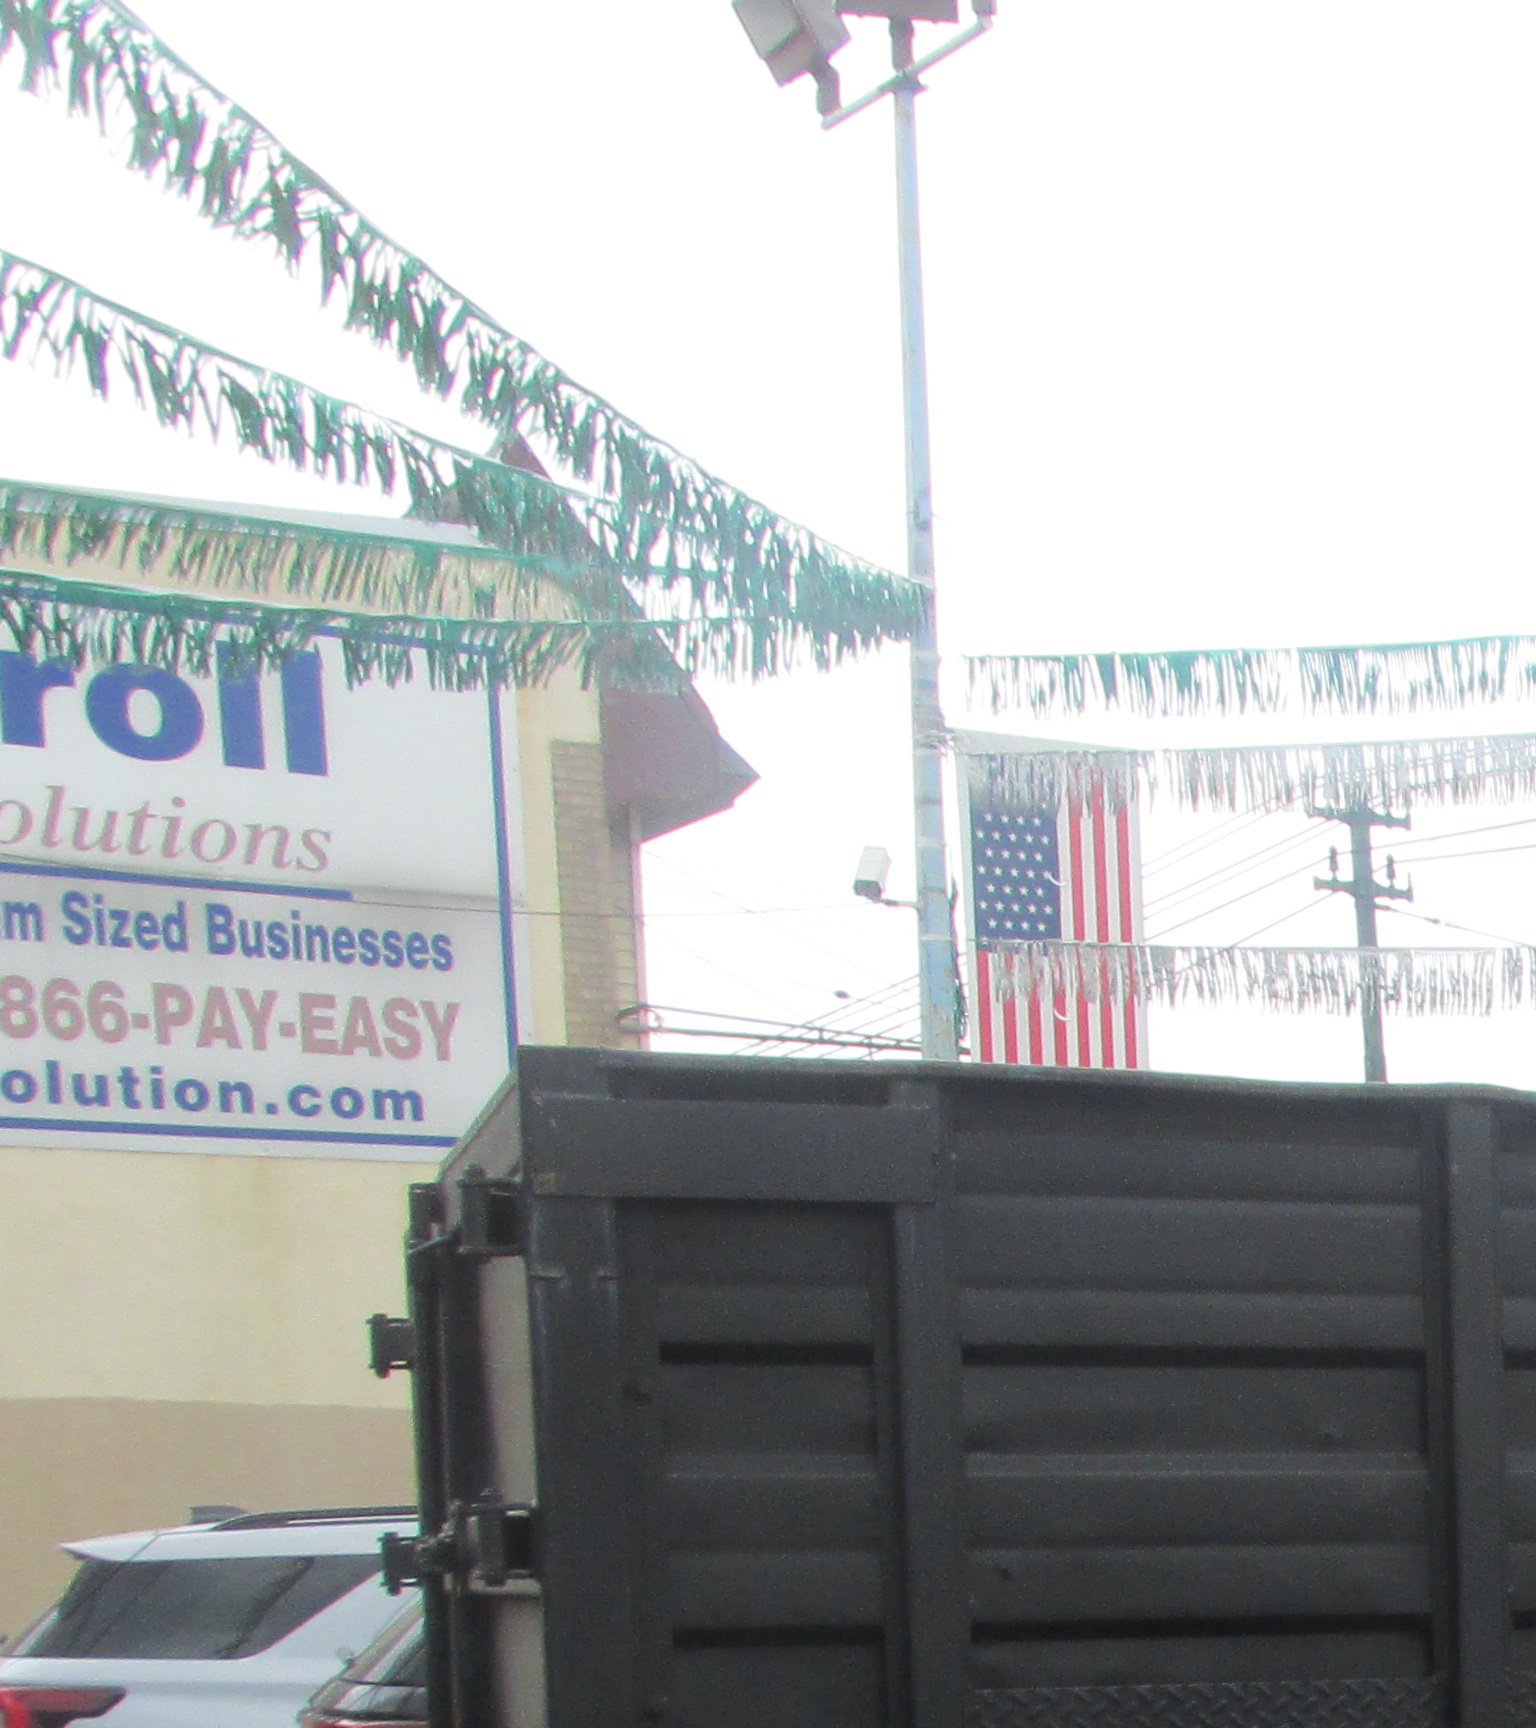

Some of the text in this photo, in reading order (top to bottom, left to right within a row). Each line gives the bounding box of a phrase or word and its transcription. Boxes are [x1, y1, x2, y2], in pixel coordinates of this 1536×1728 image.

[0, 785, 331, 871] olutions
[61, 890, 188, 952] Sized
[205, 902, 454, 971] Businesses
[0, 974, 460, 1062] 866-PAY-EASY
[1, 1060, 425, 1121] olution.com
